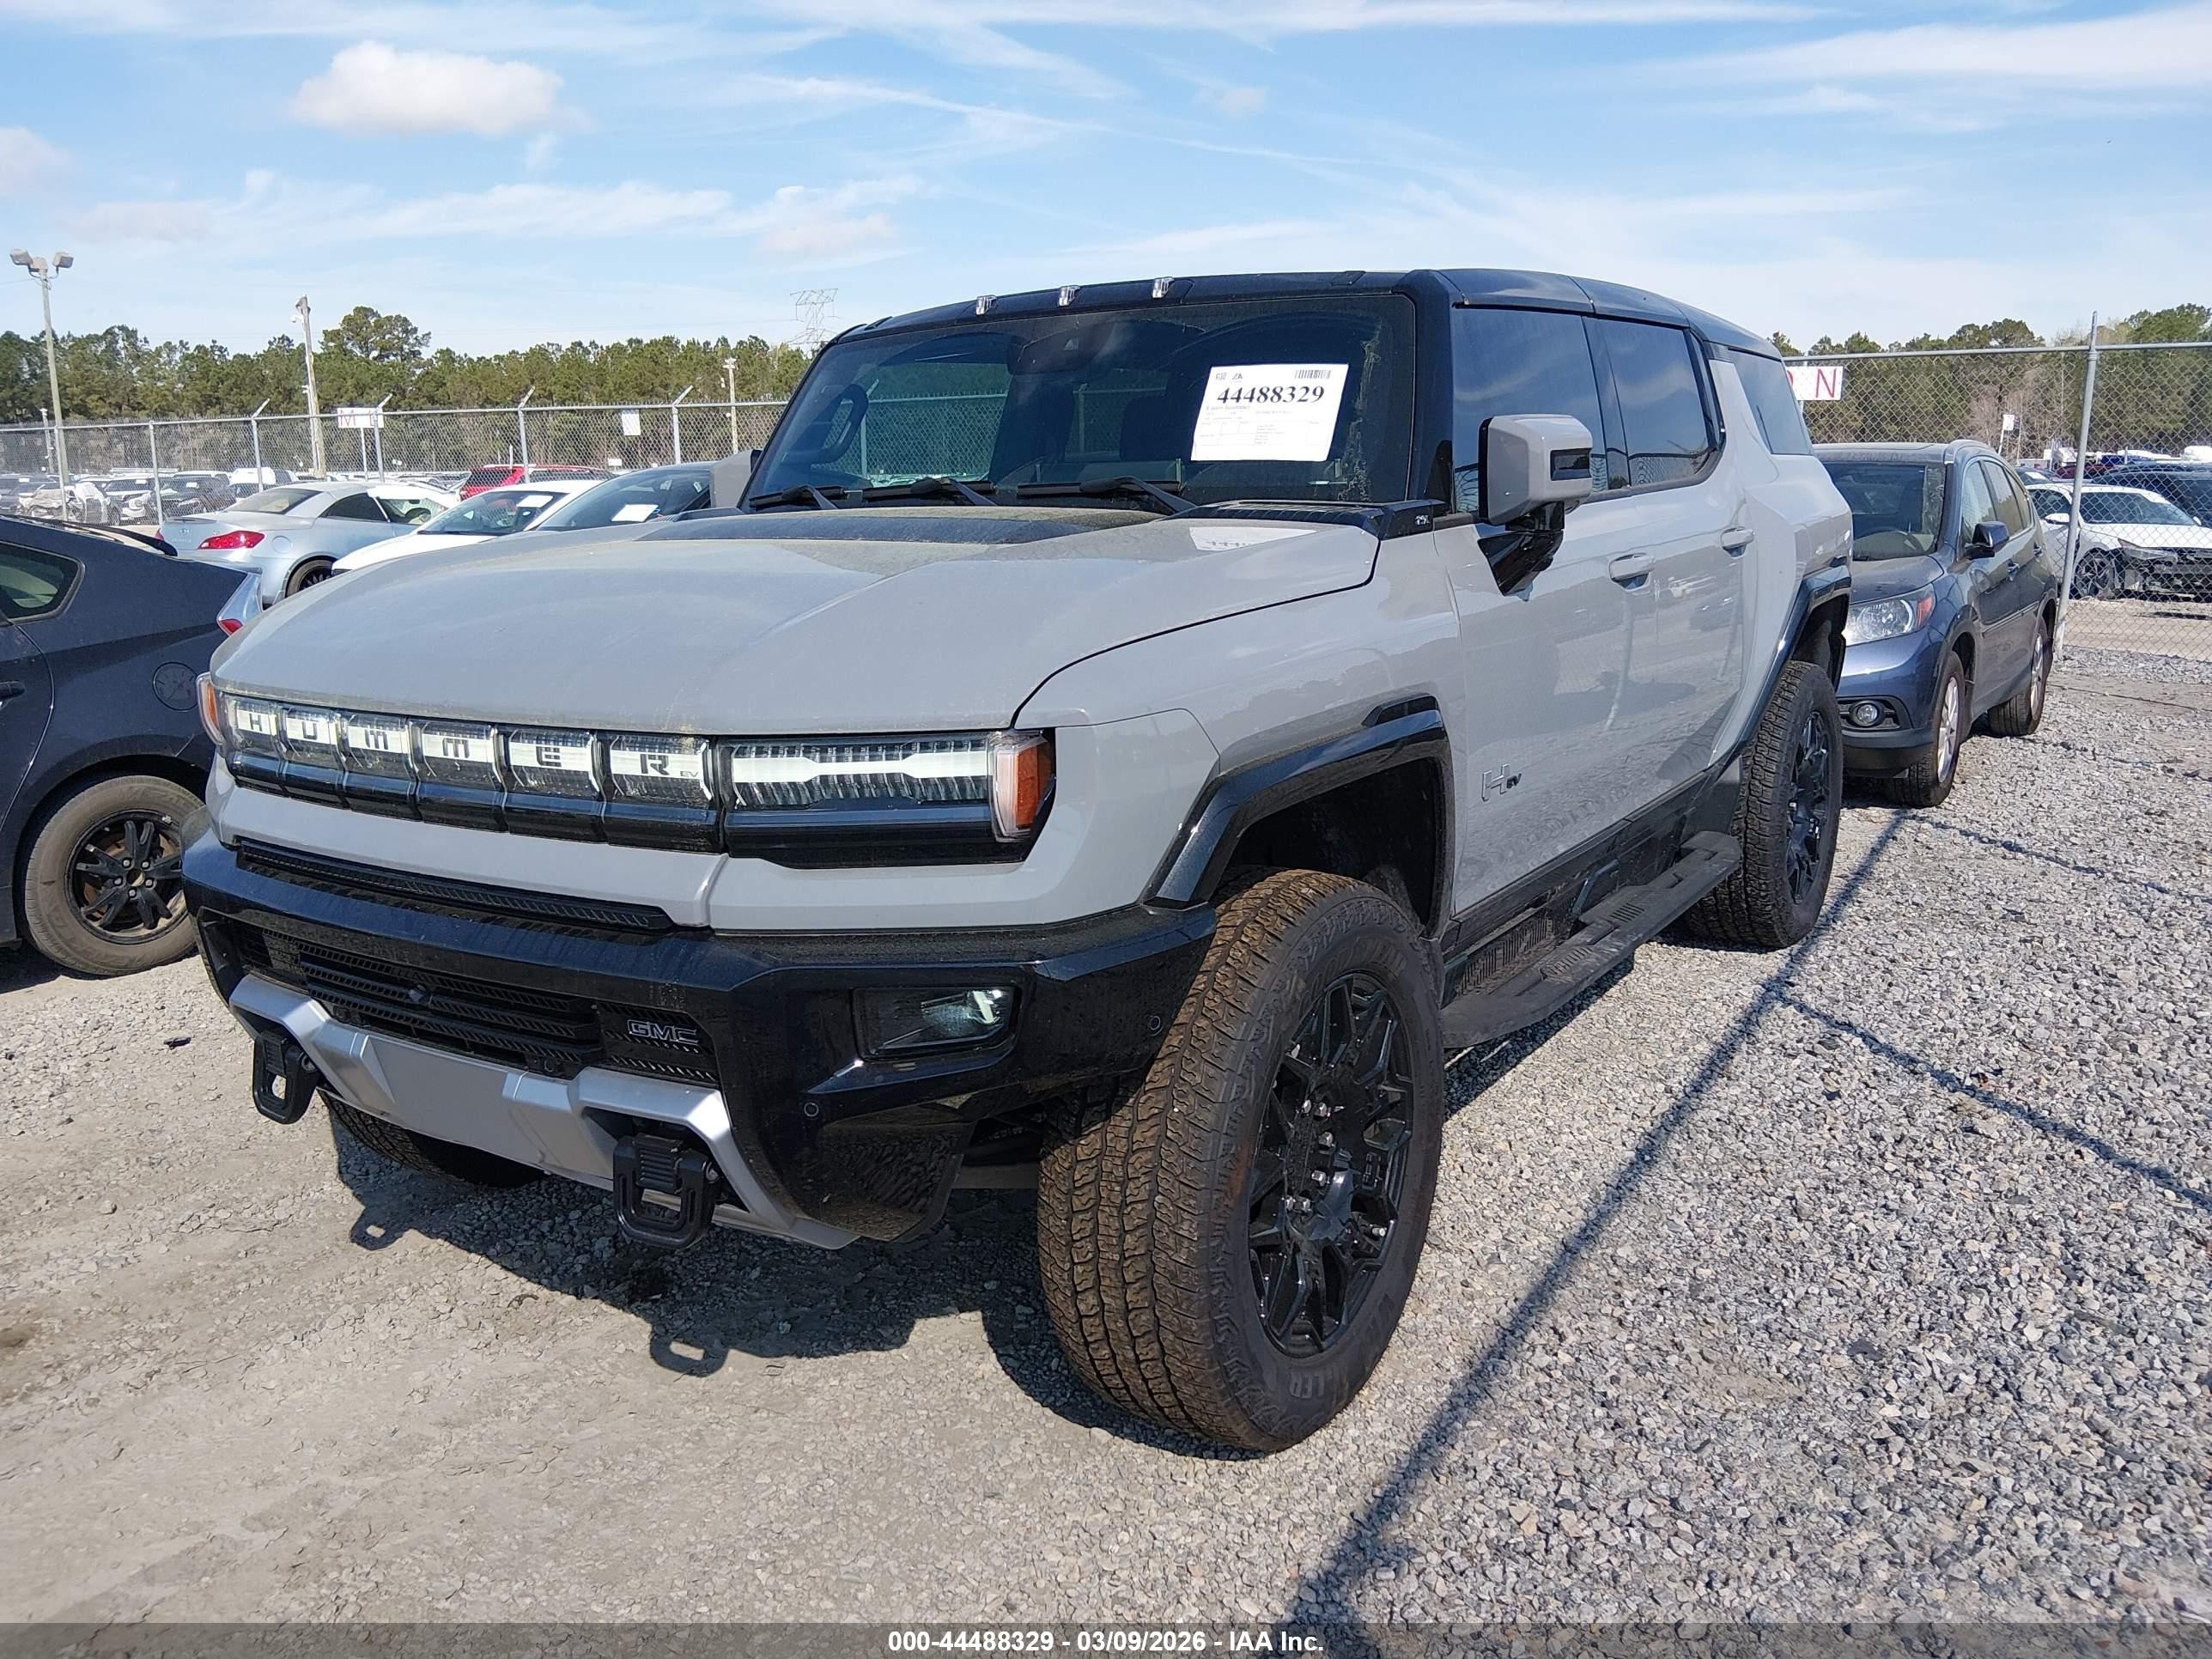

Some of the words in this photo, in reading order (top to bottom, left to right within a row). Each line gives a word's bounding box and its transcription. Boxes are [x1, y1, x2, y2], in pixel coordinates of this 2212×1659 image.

[1217, 386, 1324, 404] 44488329
[1815, 368, 1837, 398] N
[249, 713, 669, 775] HUMMER
[628, 1019, 700, 1046] GMC
